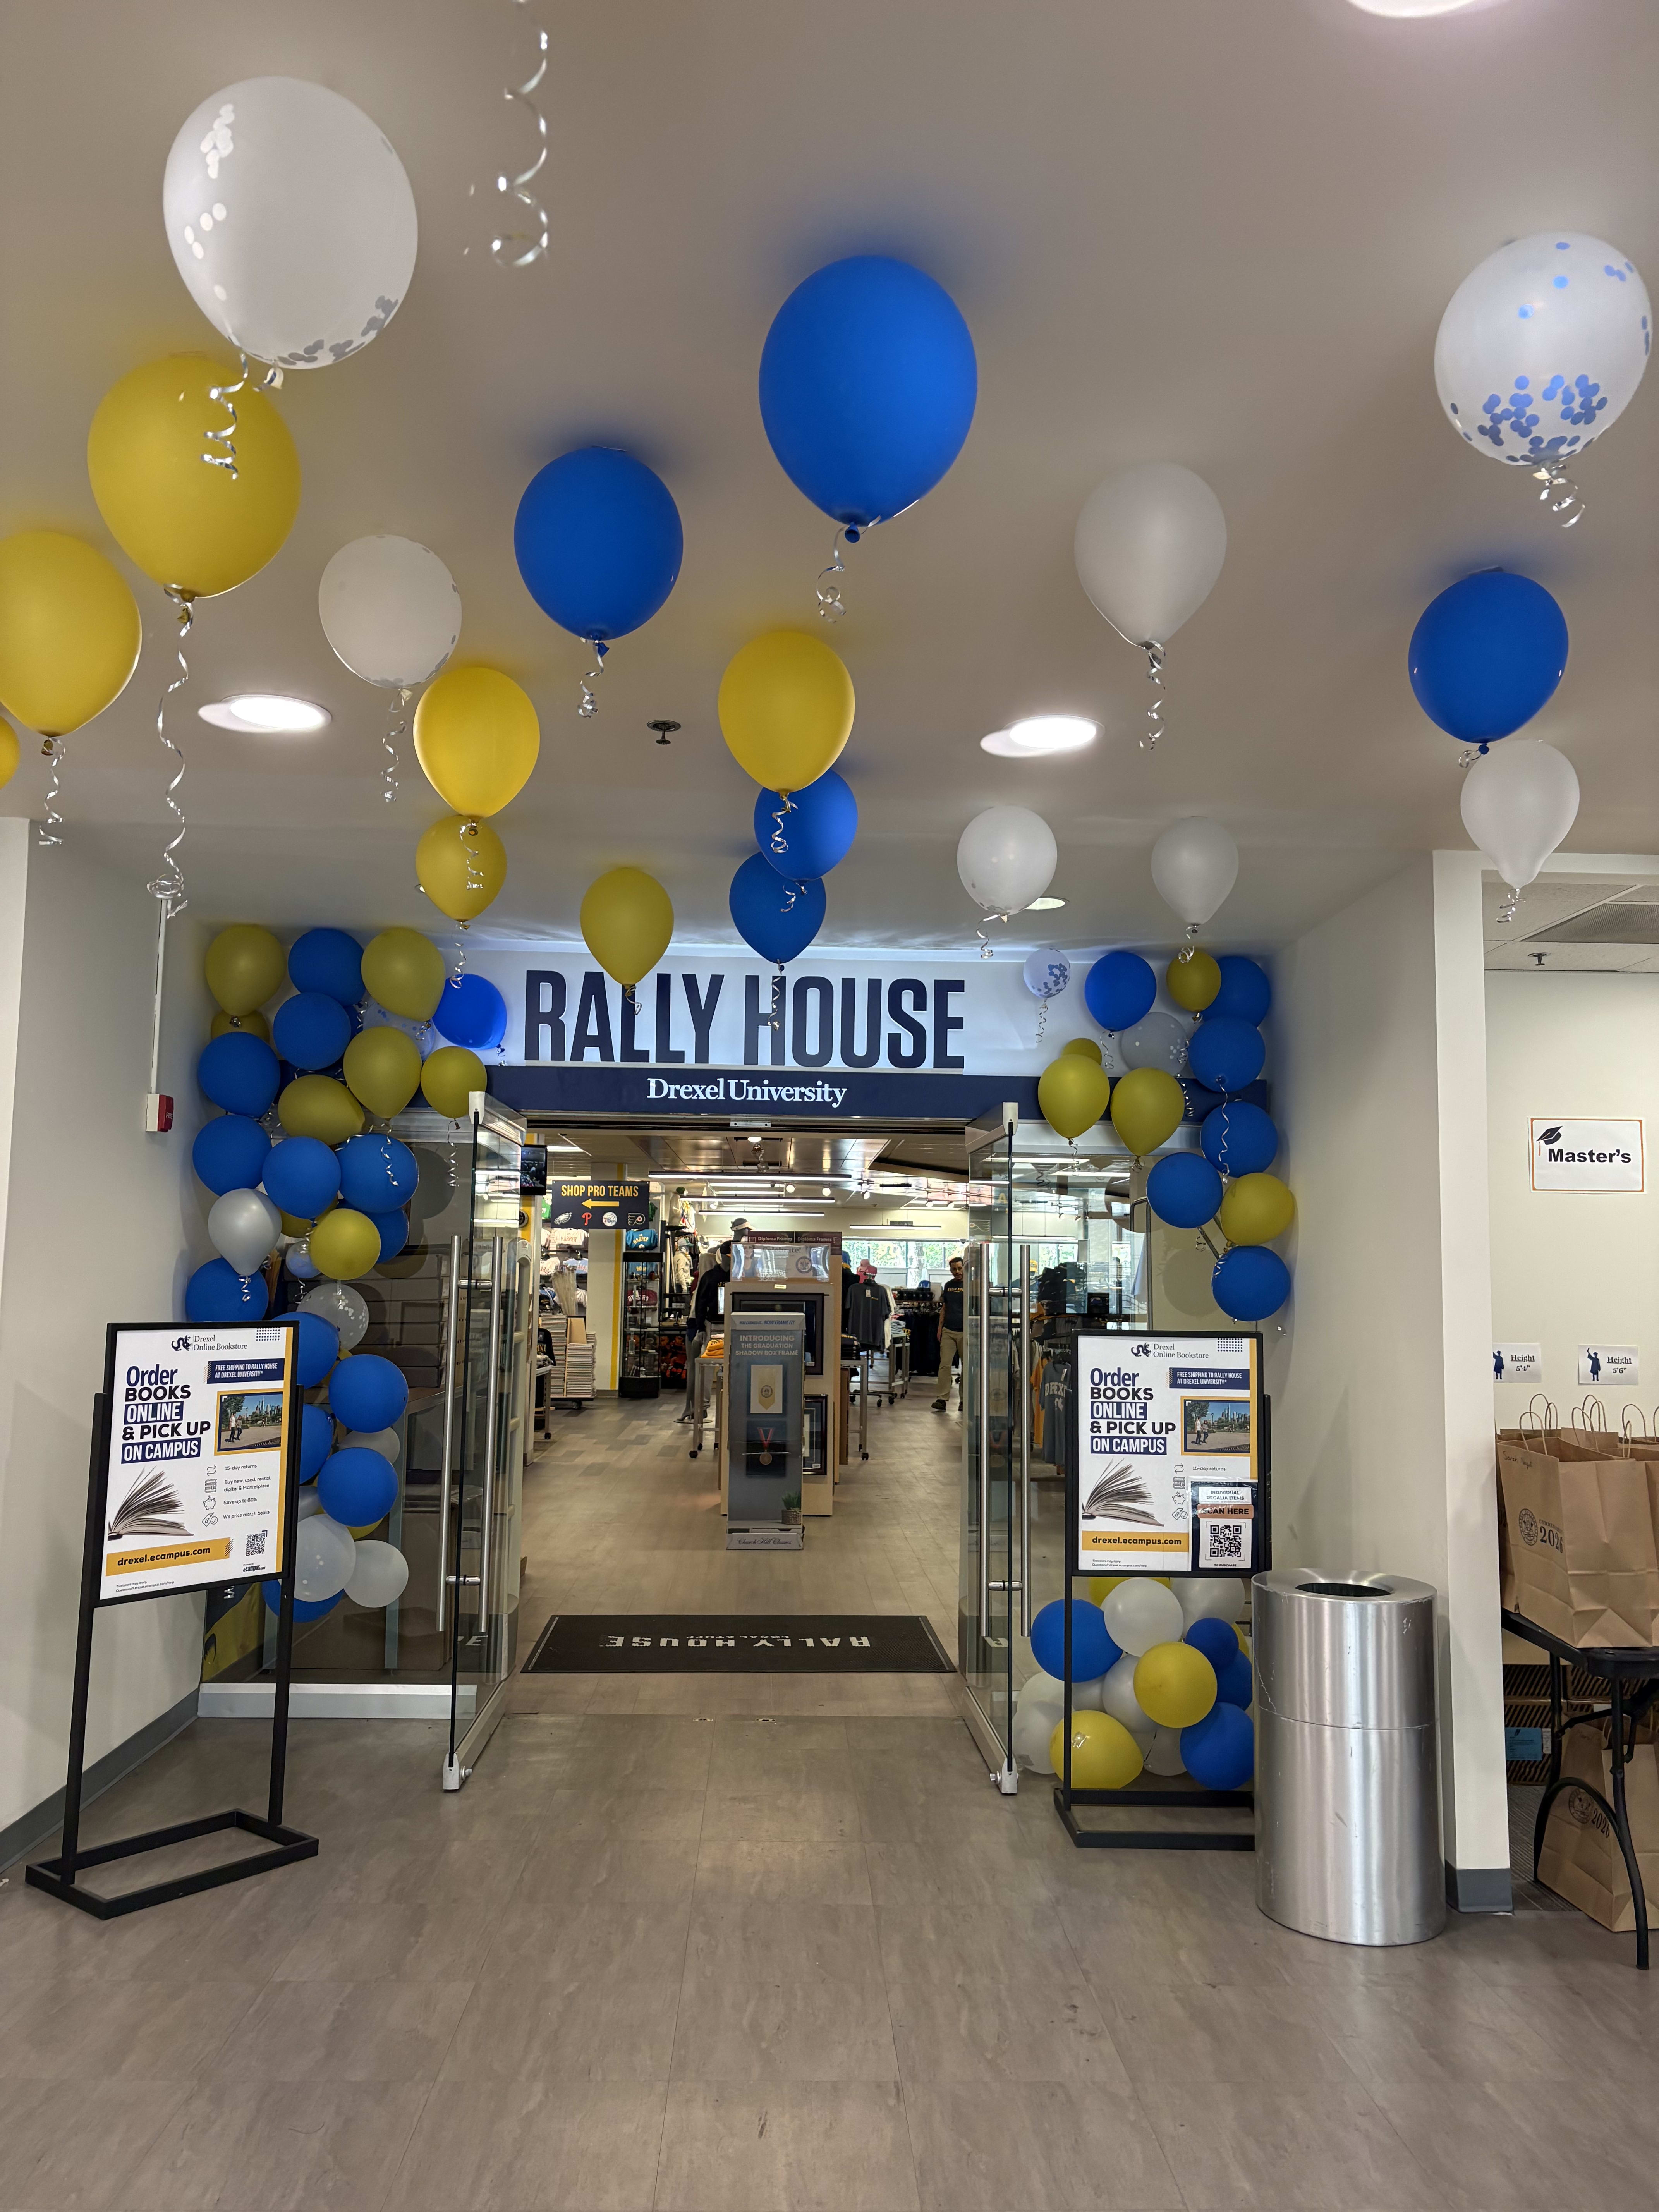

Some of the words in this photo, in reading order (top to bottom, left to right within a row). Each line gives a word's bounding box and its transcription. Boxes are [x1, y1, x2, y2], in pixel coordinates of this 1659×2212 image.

[524, 970, 724, 1064] RALLY
[744, 974, 965, 1069] HOUSE
[647, 1078, 725, 1100] Drexel
[727, 1079, 848, 1108] University
[1548, 1148, 1631, 1163] Master's
[561, 1185, 586, 1196] SHOP
[588, 1185, 605, 1197] PRO
[608, 1186, 639, 1197] TEAMS
[126, 1364, 178, 1387] Order
[1090, 1367, 1139, 1387] Order
[125, 1384, 191, 1402] BOOKS
[1090, 1387, 1154, 1401] BOOKS
[127, 1402, 181, 1423] ONLINE
[1093, 1402, 1145, 1419] ONLINE
[122, 1426, 134, 1441] &
[140, 1422, 182, 1439] PICK
[187, 1421, 211, 1436] UP
[1090, 1421, 1101, 1434] &
[1107, 1421, 1147, 1434] PICK
[1151, 1422, 1176, 1435] UP
[124, 1444, 143, 1462] ON
[145, 1440, 199, 1460] CAMPUS
[1092, 1437, 1109, 1452] ON
[1113, 1438, 1164, 1453] CAMPUS
[1092, 1536, 1182, 1546] drexel.ecampus.com
[1540, 1526, 1563, 1553] 2026
[117, 1547, 210, 1566] drexel.ecampus.com
[605, 1635, 735, 1647] HOUSE
[753, 1636, 871, 1647] RALLY
[1591, 1808, 1610, 1838] 2026
